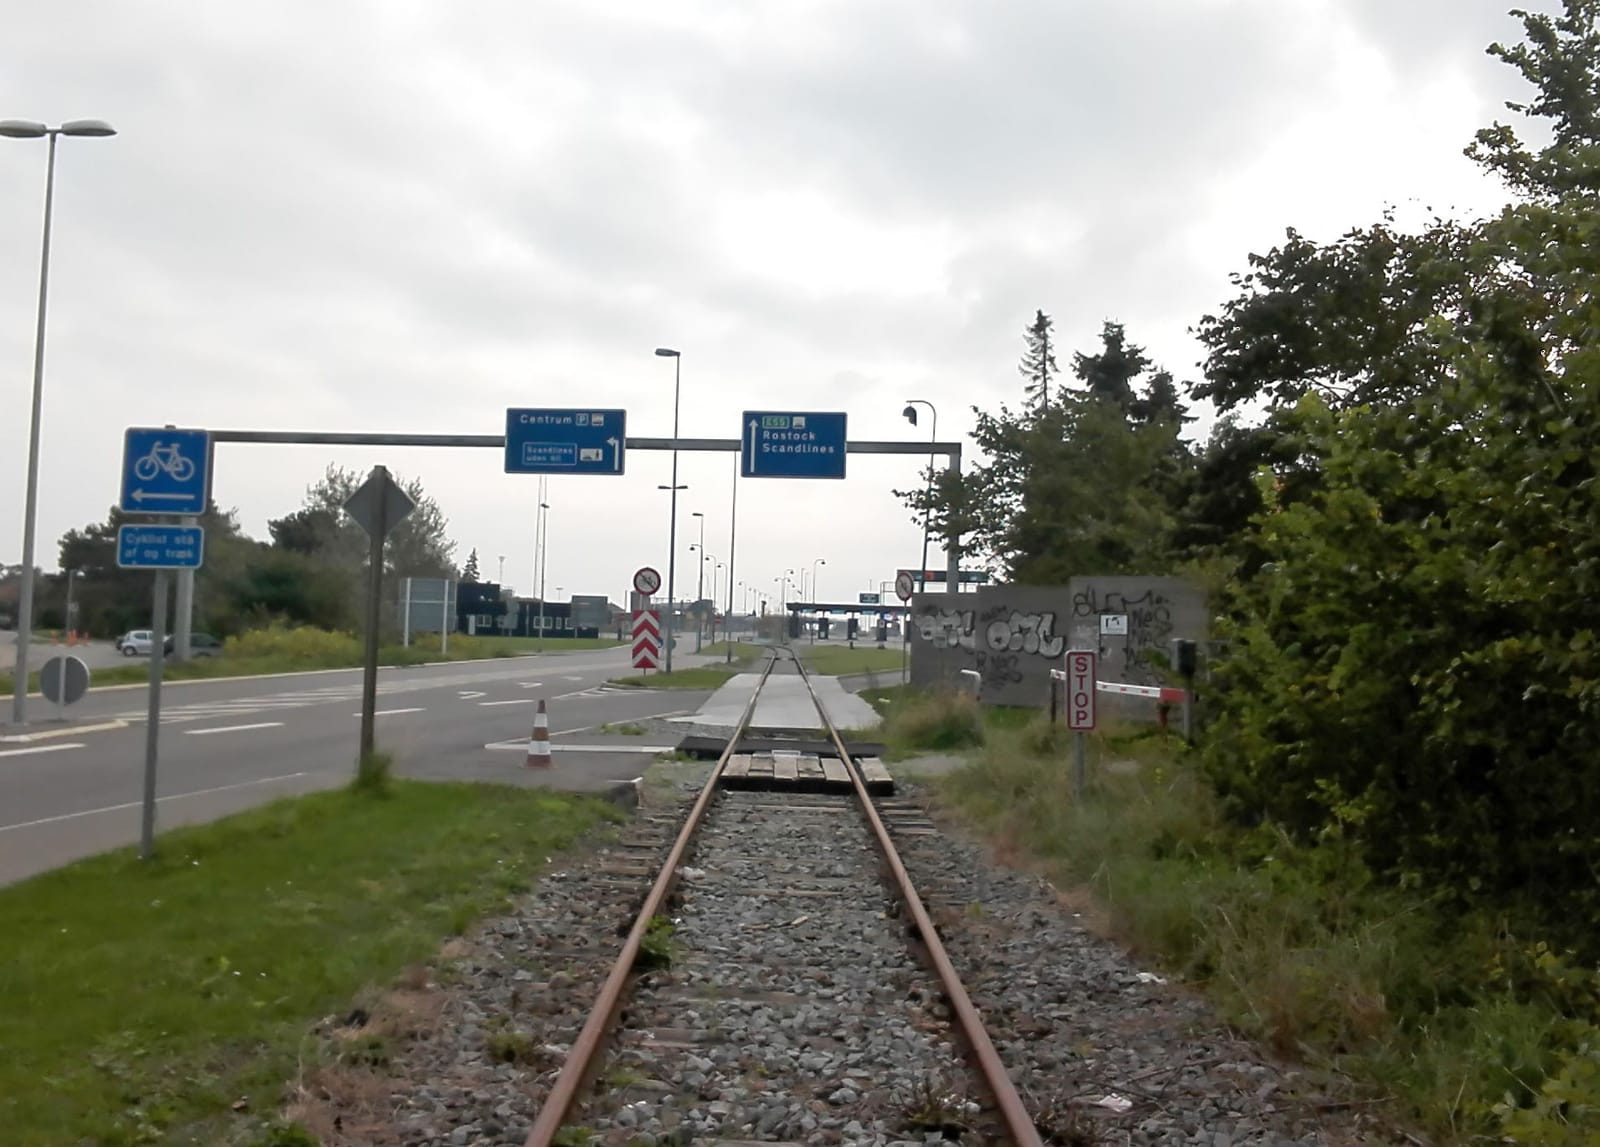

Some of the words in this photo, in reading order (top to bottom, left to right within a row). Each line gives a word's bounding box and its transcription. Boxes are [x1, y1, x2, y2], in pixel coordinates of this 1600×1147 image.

[520, 414, 572, 425] Centrum
[762, 430, 816, 440] Rostock
[762, 443, 835, 453] Scandlines
[1074, 656, 1089, 726] STOP
